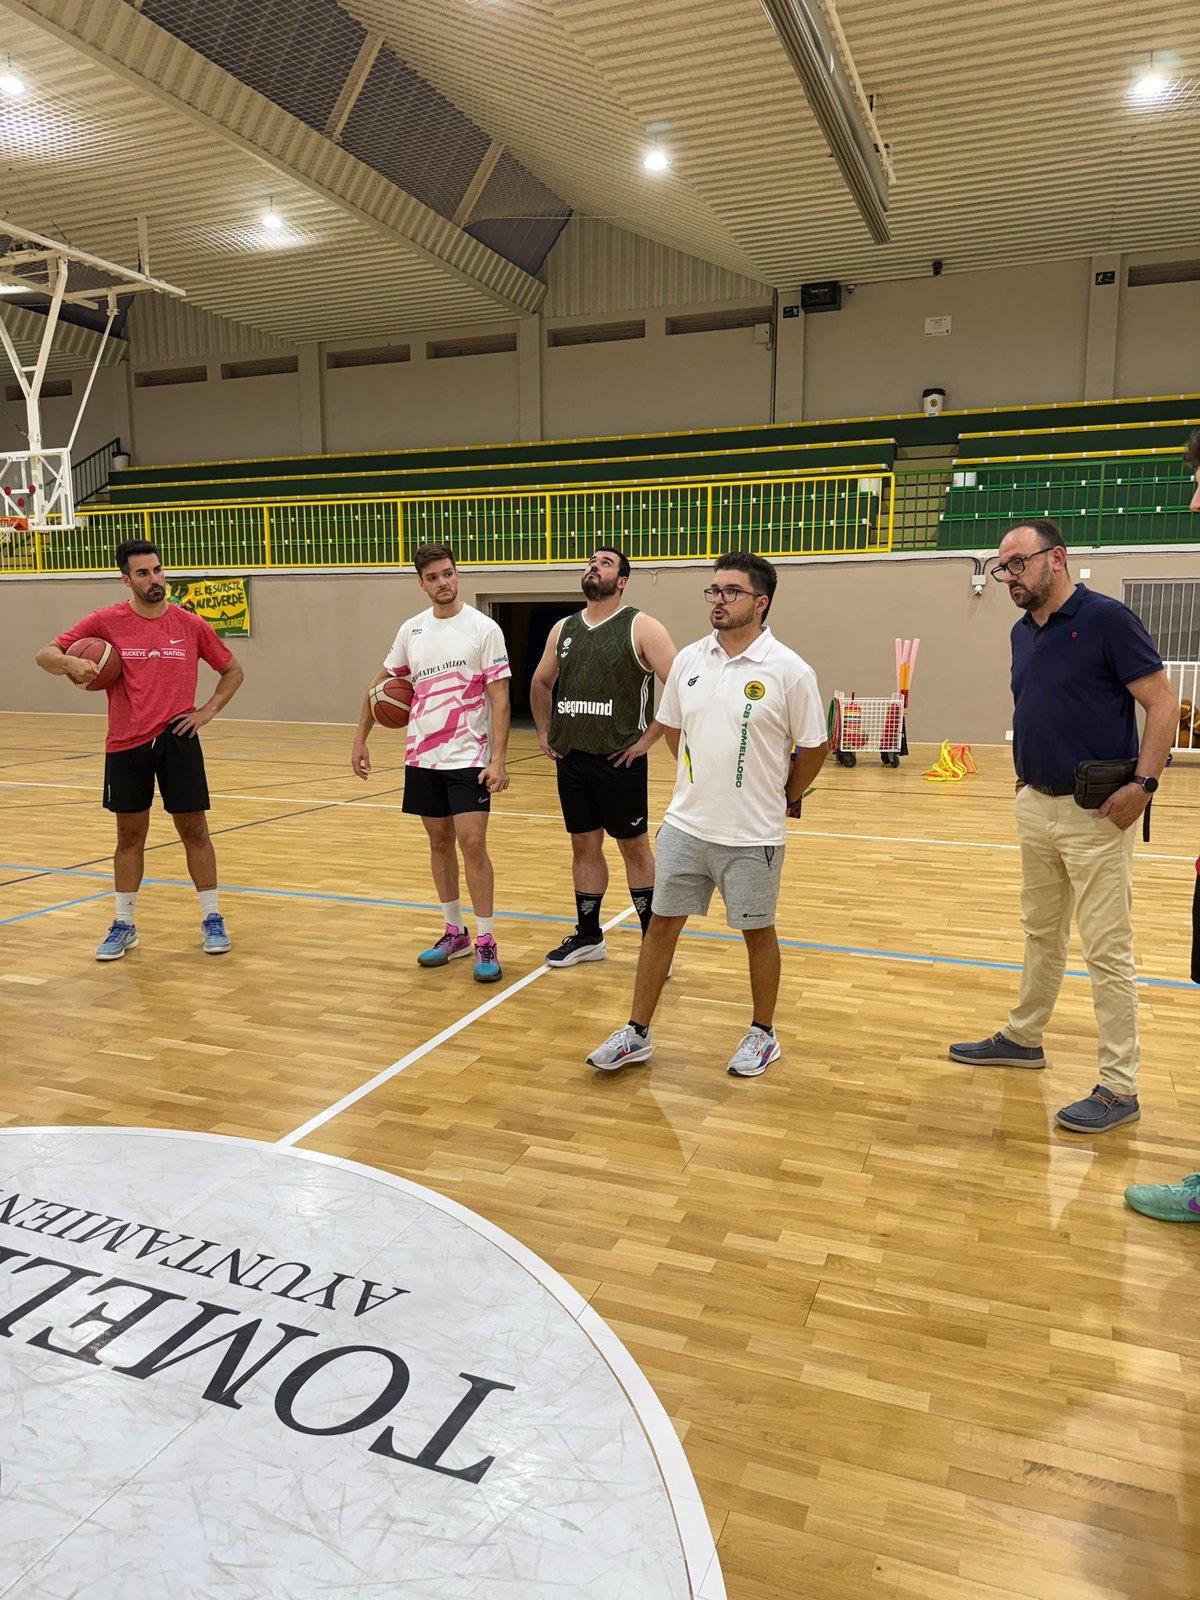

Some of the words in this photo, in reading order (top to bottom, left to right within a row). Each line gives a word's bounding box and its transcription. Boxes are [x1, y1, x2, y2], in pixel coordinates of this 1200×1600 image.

[194, 586, 203, 597] EL
[163, 650, 186, 658] NATION
[557, 697, 613, 718] siegmund
[743, 703, 752, 719] CB
[735, 722, 748, 788] TOMELLOSO
[0, 1189, 411, 1317] AYUNTAMIEN
